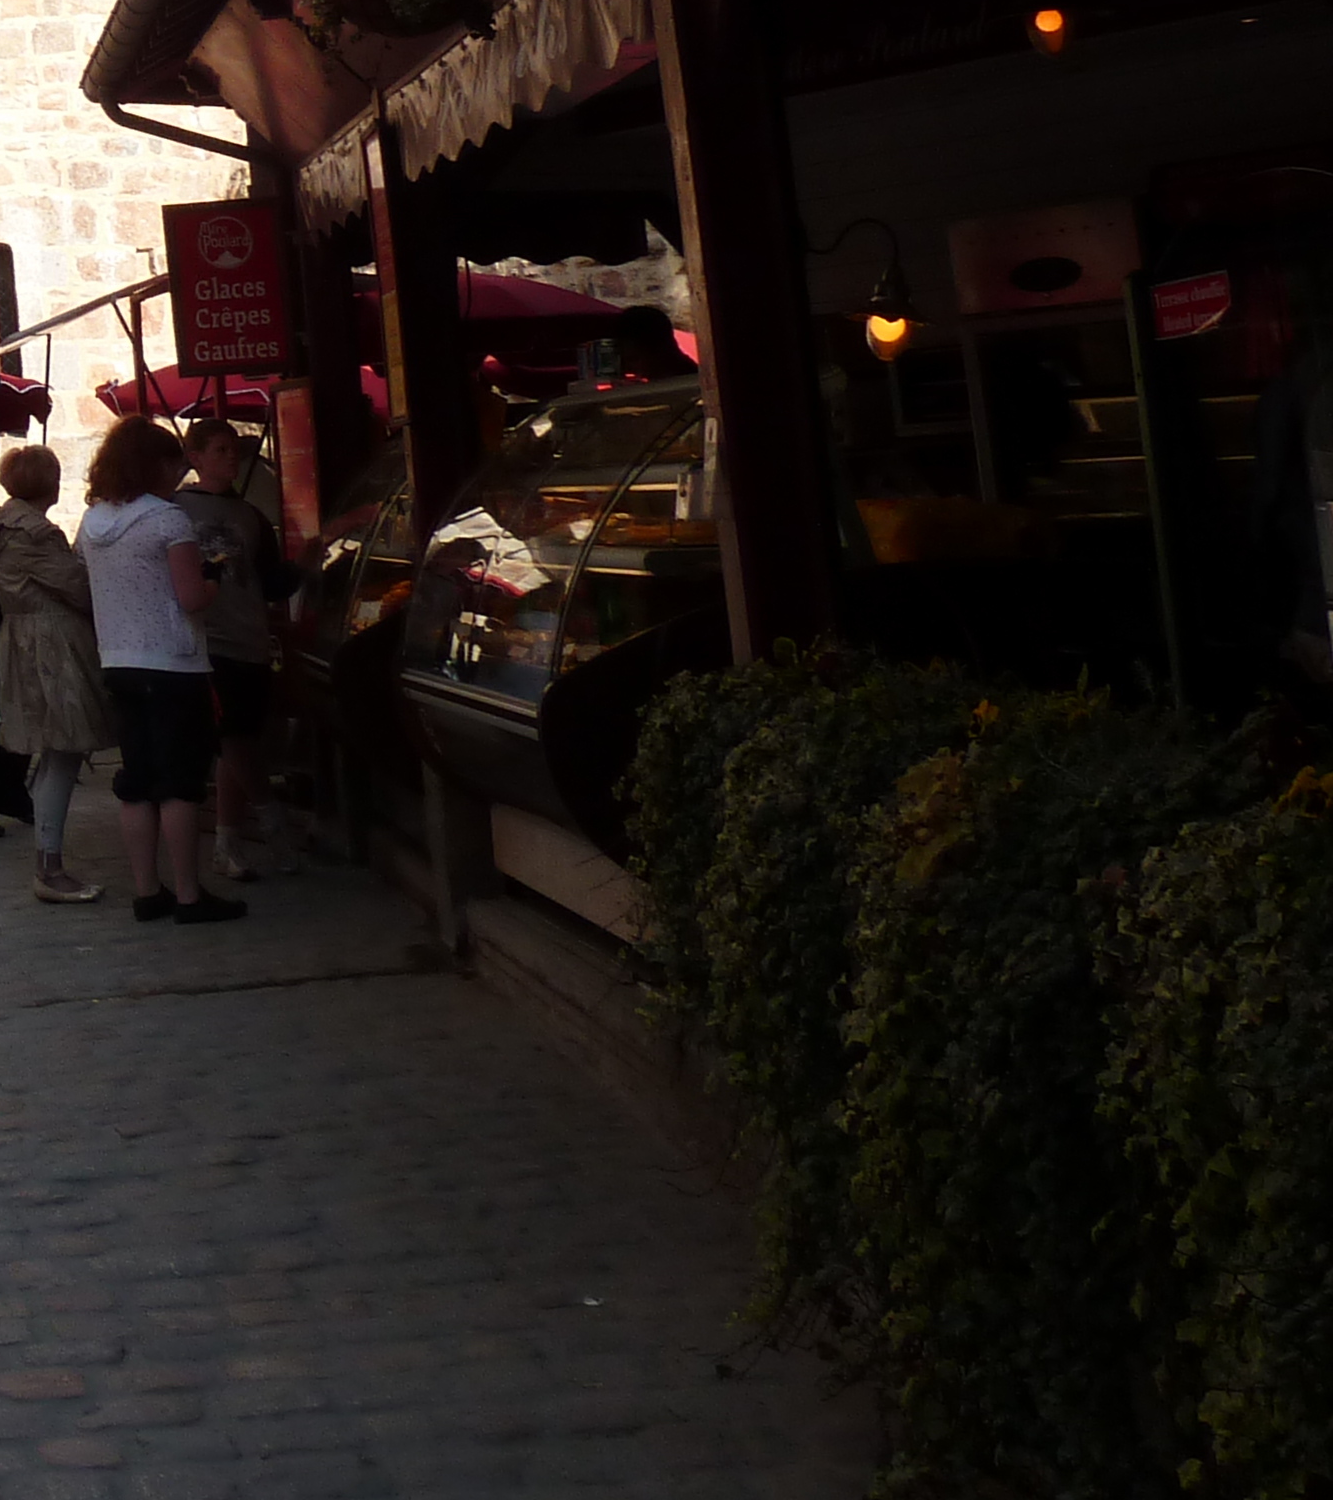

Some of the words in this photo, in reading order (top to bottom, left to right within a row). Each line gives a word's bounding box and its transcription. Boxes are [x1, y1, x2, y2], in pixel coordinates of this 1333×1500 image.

[195, 277, 266, 301] Glaces
[195, 306, 271, 333] Crêpes
[194, 337, 279, 362] Gaufres
